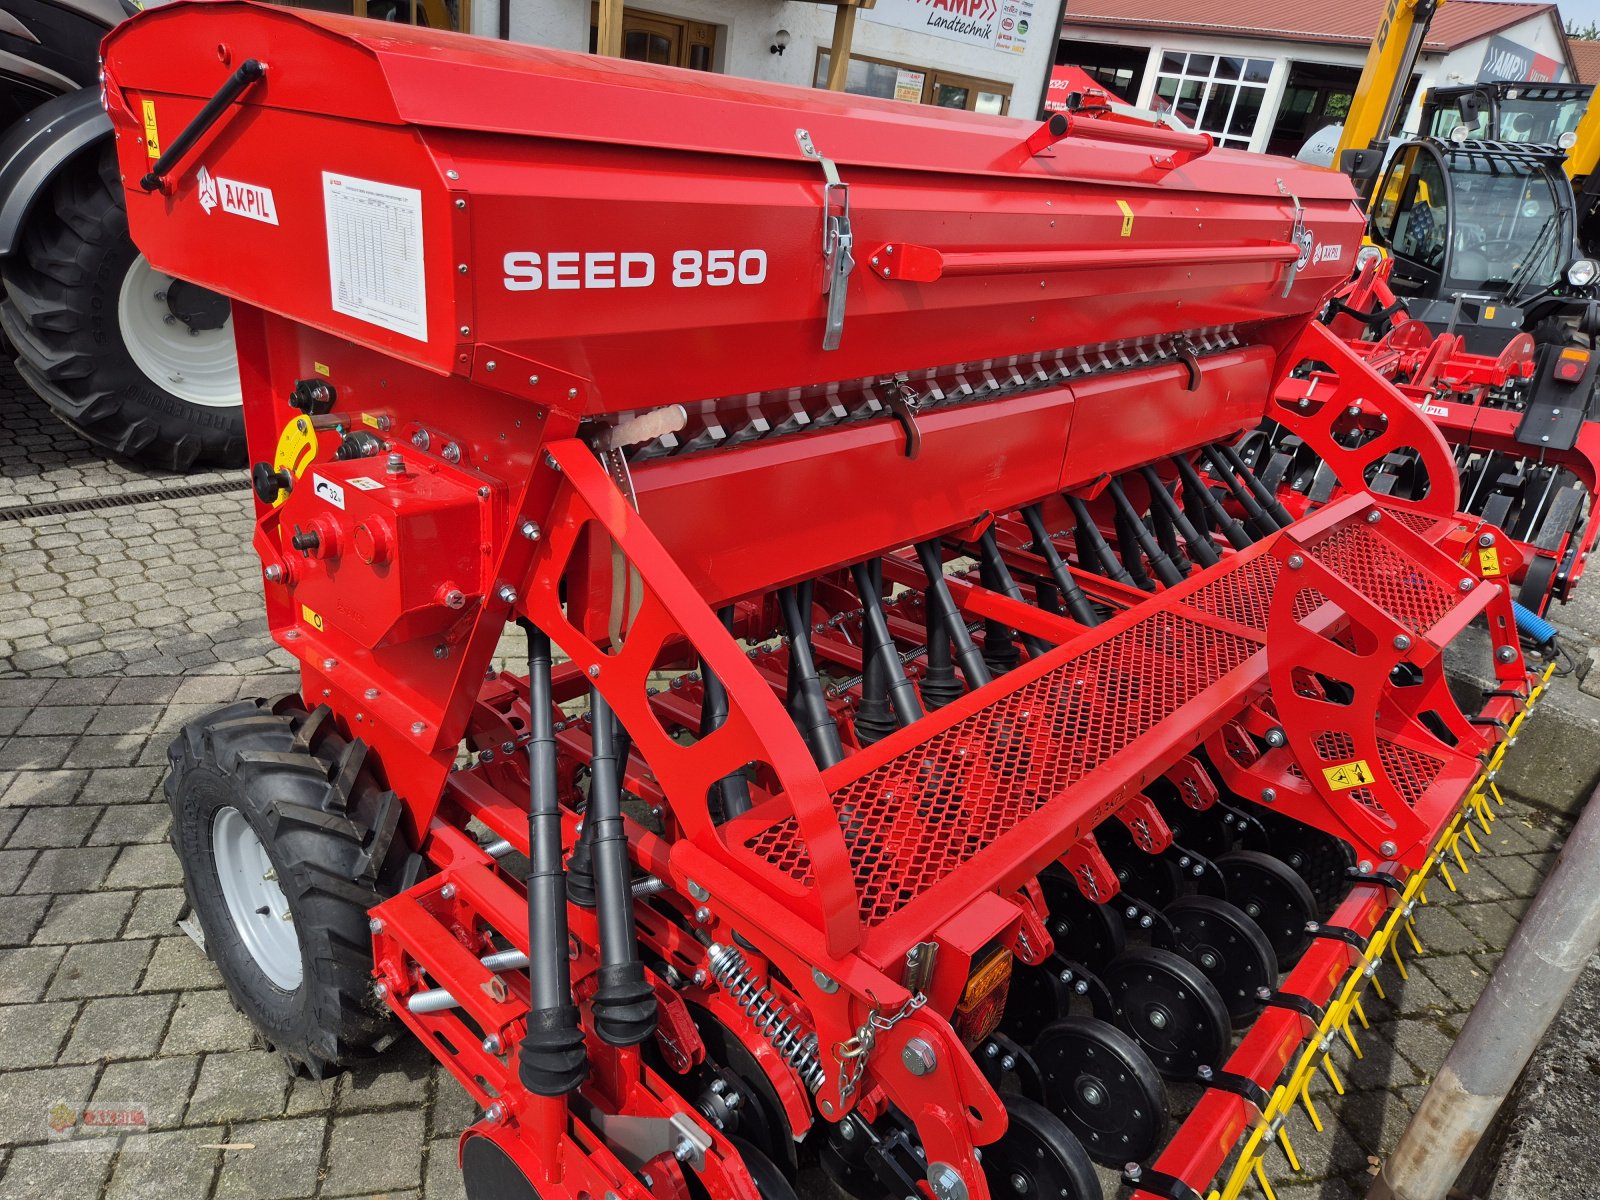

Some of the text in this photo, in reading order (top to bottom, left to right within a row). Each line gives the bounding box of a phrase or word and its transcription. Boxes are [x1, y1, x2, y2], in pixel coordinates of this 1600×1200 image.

[926, 12, 993, 39] Landtechnik
[1492, 51, 1521, 79] AMP
[225, 183, 270, 218] AKPIL
[503, 249, 768, 291] SEED 850
[329, 488, 338, 501] 32
